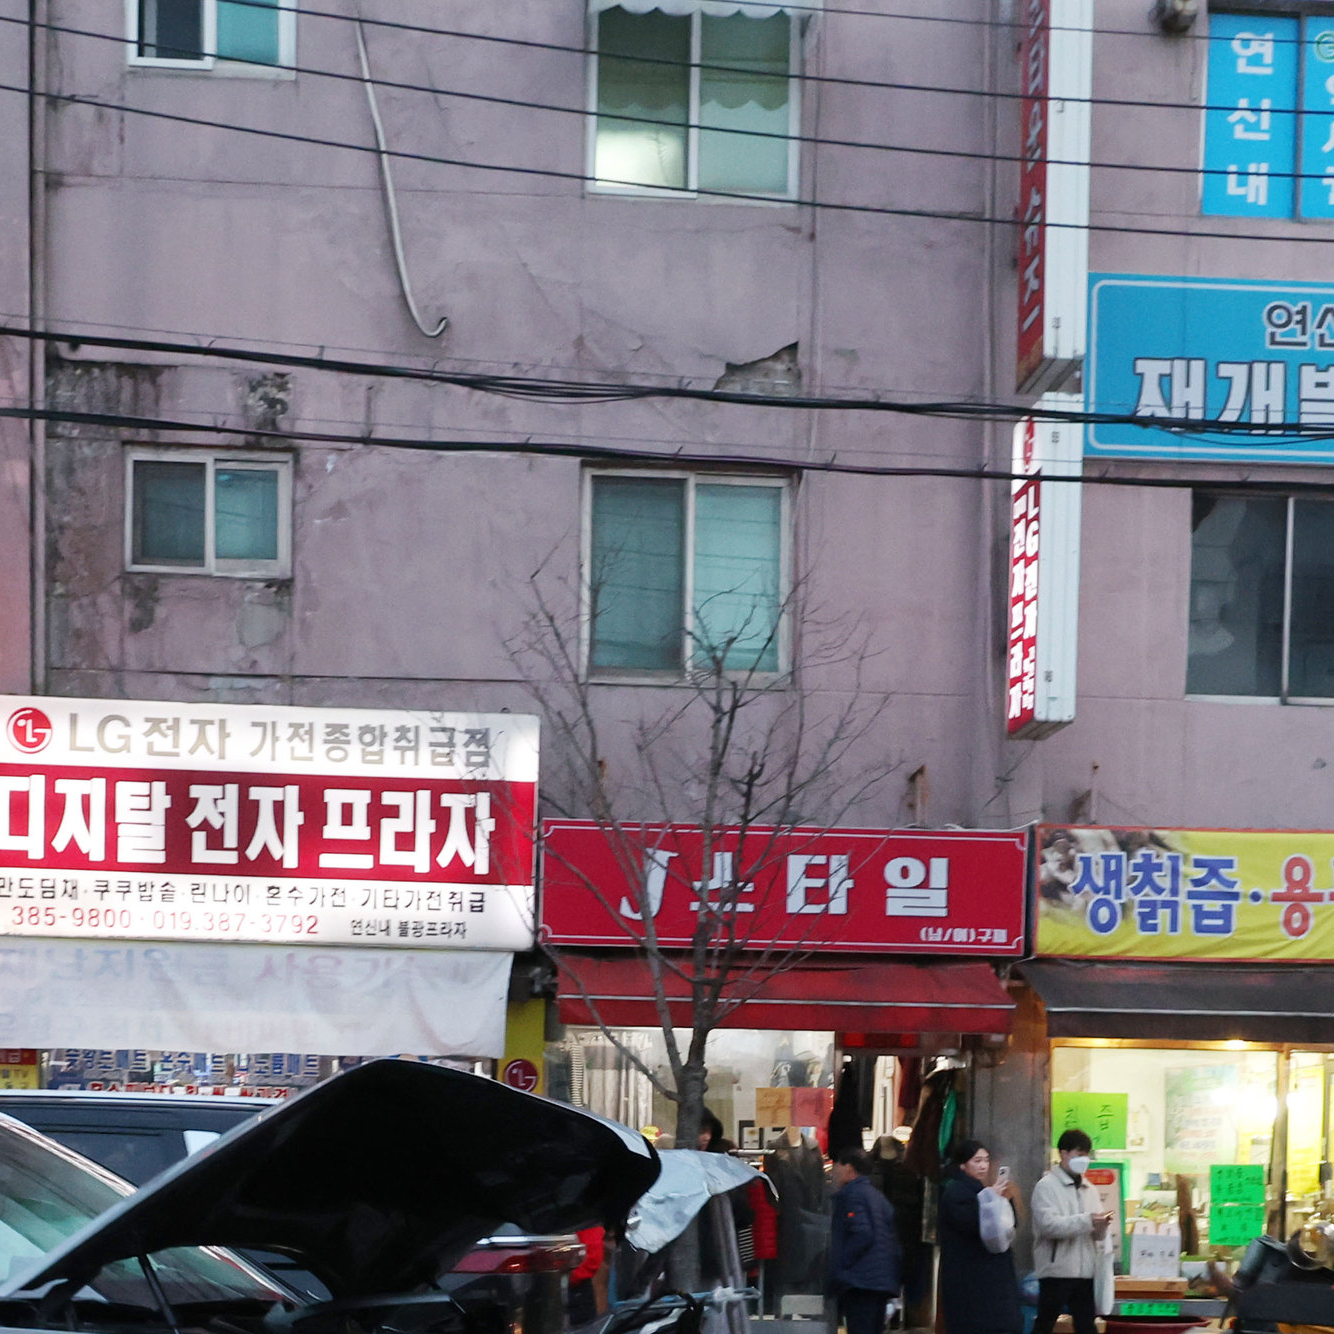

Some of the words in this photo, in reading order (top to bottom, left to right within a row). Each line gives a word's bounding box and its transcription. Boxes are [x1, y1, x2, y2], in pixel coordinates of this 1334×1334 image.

[1227, 32, 1274, 206] 연신내
[68, 712, 231, 761] LG전자
[249, 719, 494, 769] 가전종합취급점
[185, 781, 305, 868] 전자
[317, 788, 497, 876] 프라자
[11, 904, 132, 929] 385-9800
